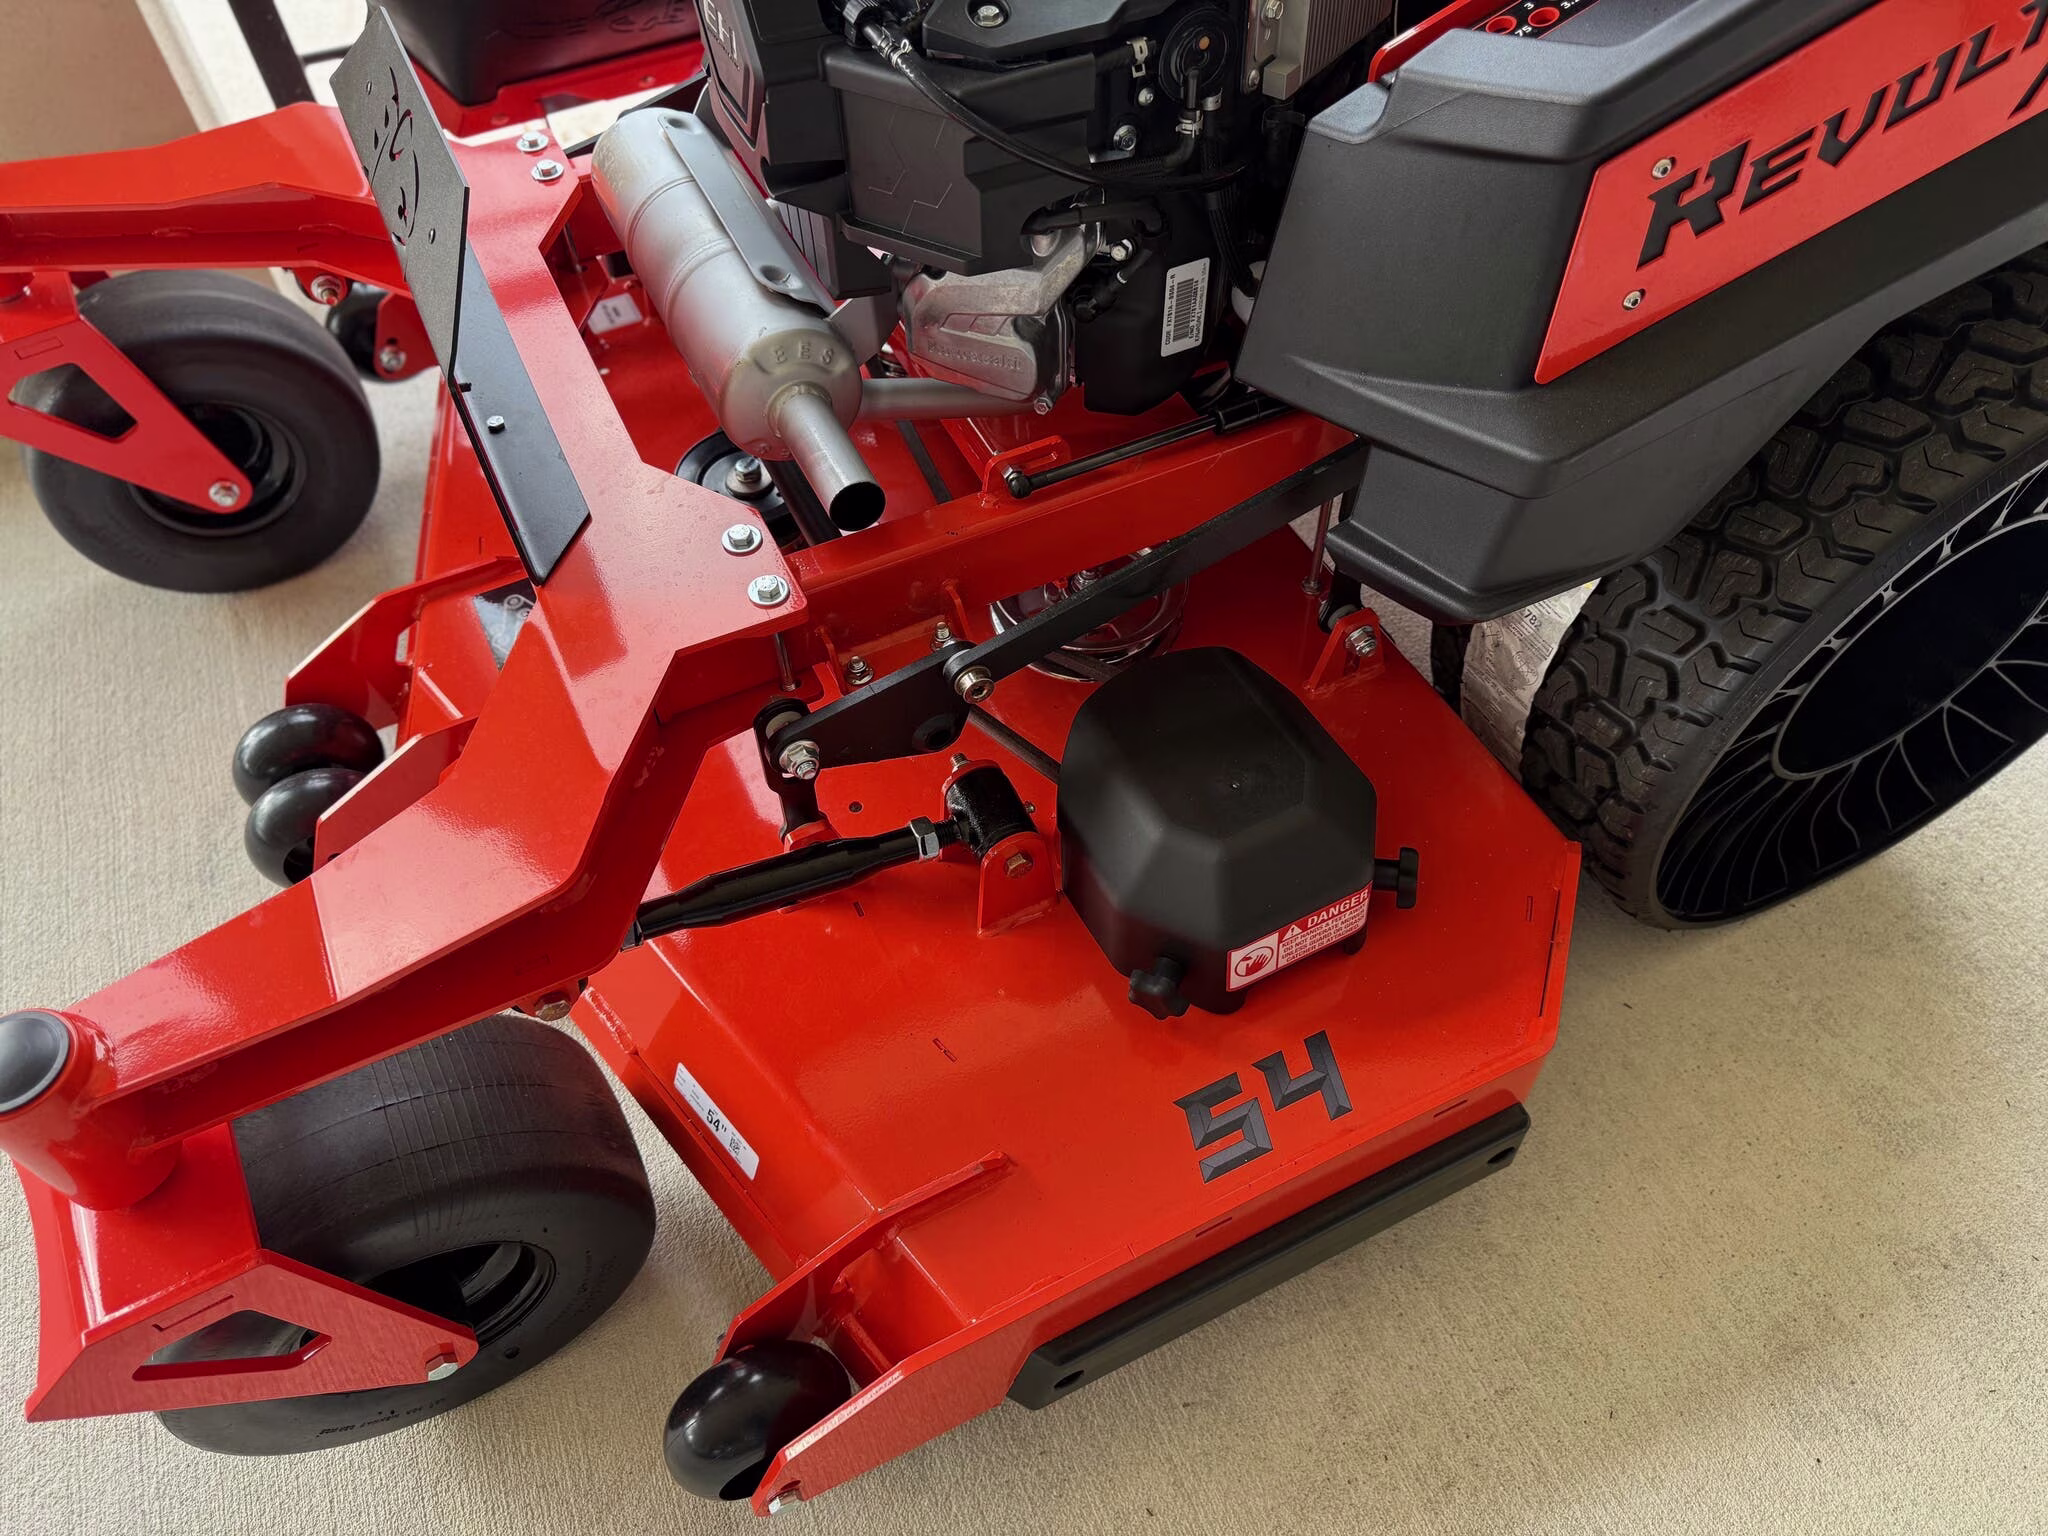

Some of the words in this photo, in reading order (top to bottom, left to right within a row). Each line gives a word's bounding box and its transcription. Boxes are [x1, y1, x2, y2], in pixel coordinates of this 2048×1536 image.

[1523, 2, 1535, 10] 3
[1307, 889, 1369, 928] DANGER
[1282, 937, 1299, 948] KEEP
[1300, 927, 1324, 939] HANDS
[1331, 914, 1347, 925] FEET
[1347, 903, 1366, 917] AWAY
[1295, 938, 1308, 949] NOT
[1309, 925, 1339, 941] OPERATE
[1282, 944, 1308, 959] UNLESS
[1308, 933, 1332, 947] GUARD
[1286, 944, 1316, 962] CATCHER
[1173, 1030, 1353, 1184] 54
[706, 1108, 727, 1132] 54"
